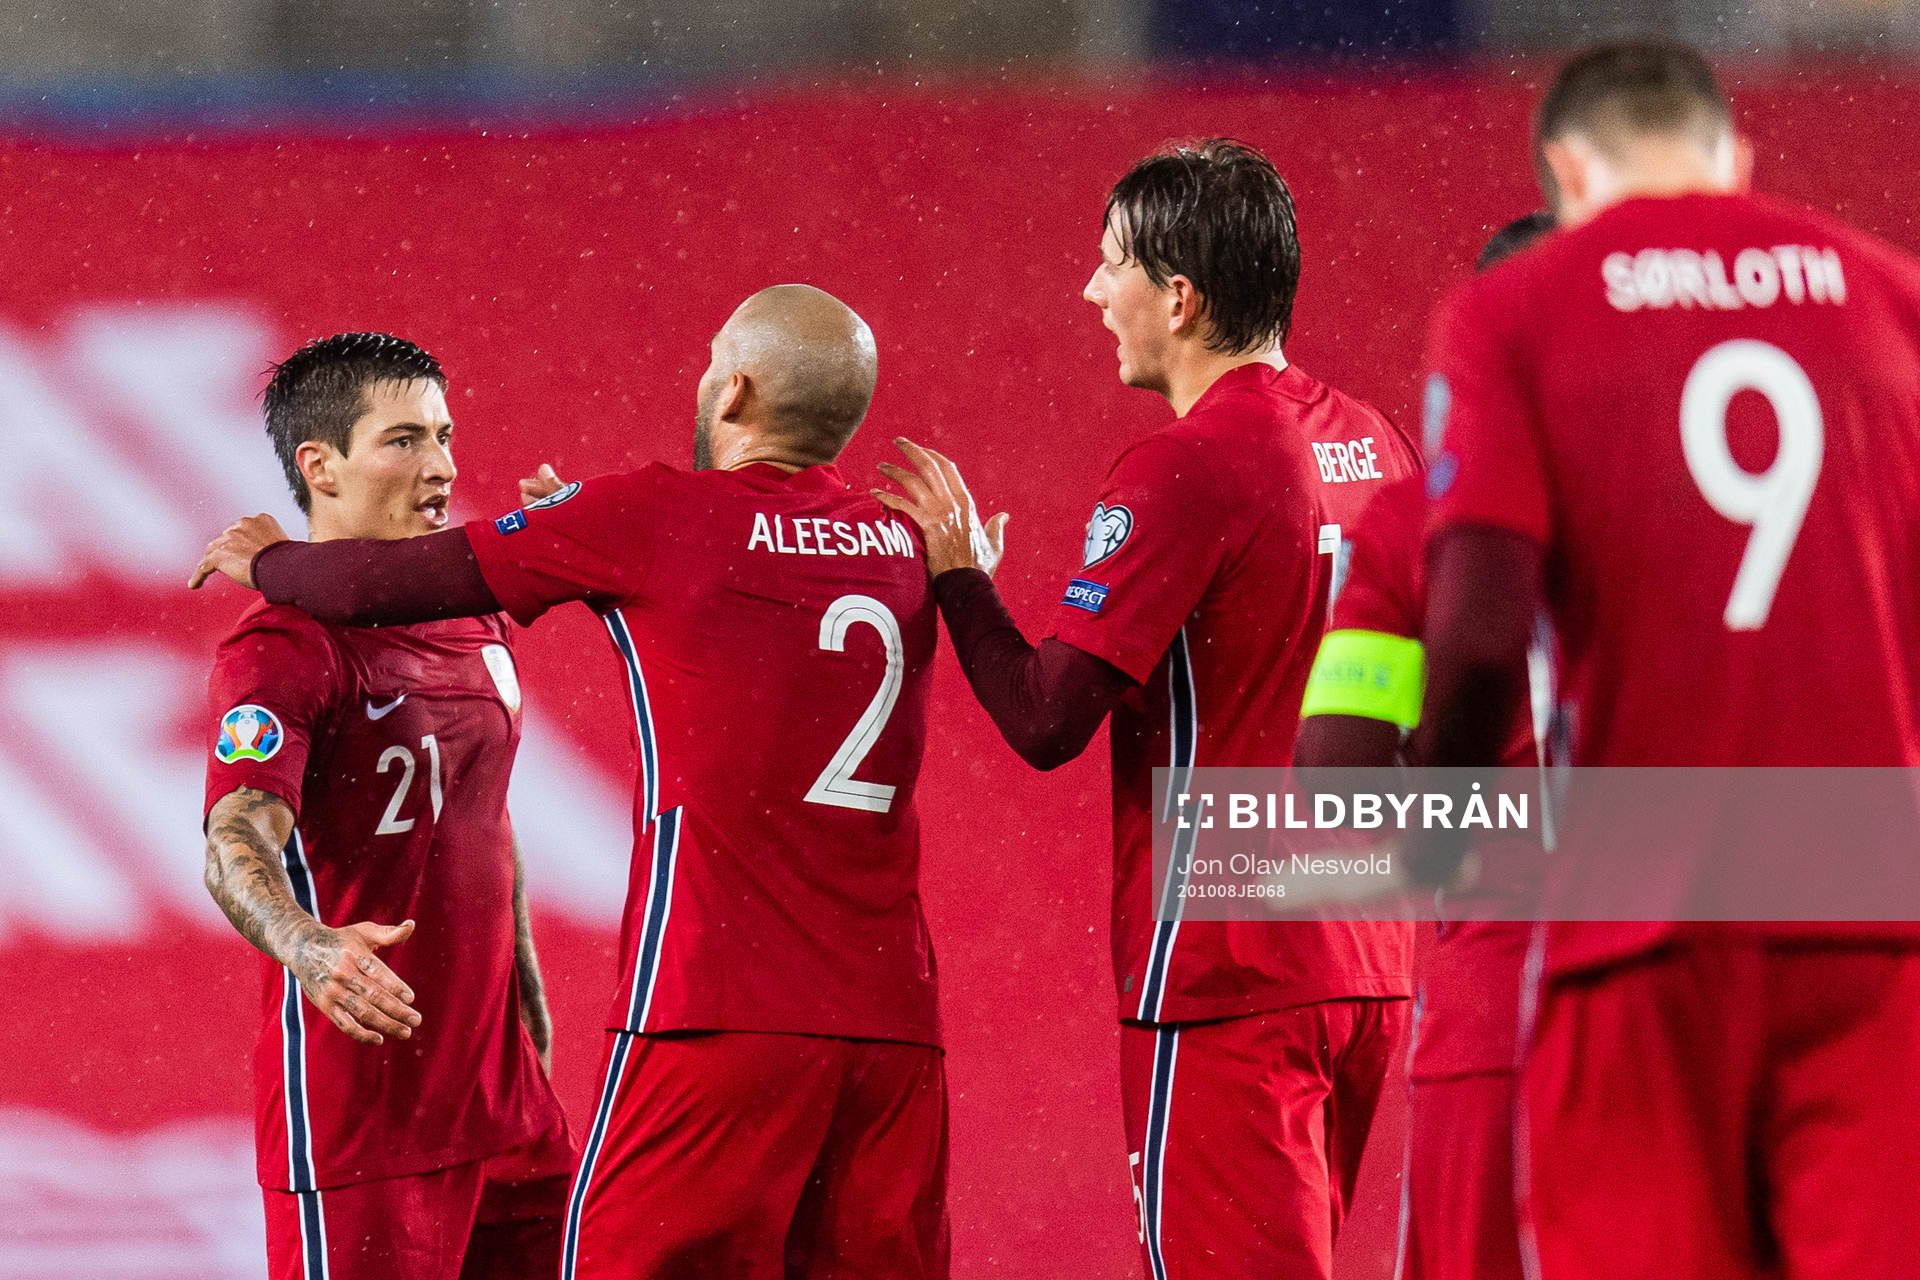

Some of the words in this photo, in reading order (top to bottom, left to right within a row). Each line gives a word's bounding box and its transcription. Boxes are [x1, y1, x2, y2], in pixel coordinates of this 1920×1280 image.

[1602, 244, 1847, 311] SØRLOTH
[1311, 436, 1383, 483] BERGE
[1679, 339, 1825, 630] 9
[747, 512, 915, 558] ALEESAMI
[803, 594, 904, 813] 2
[374, 733, 443, 836] 21
